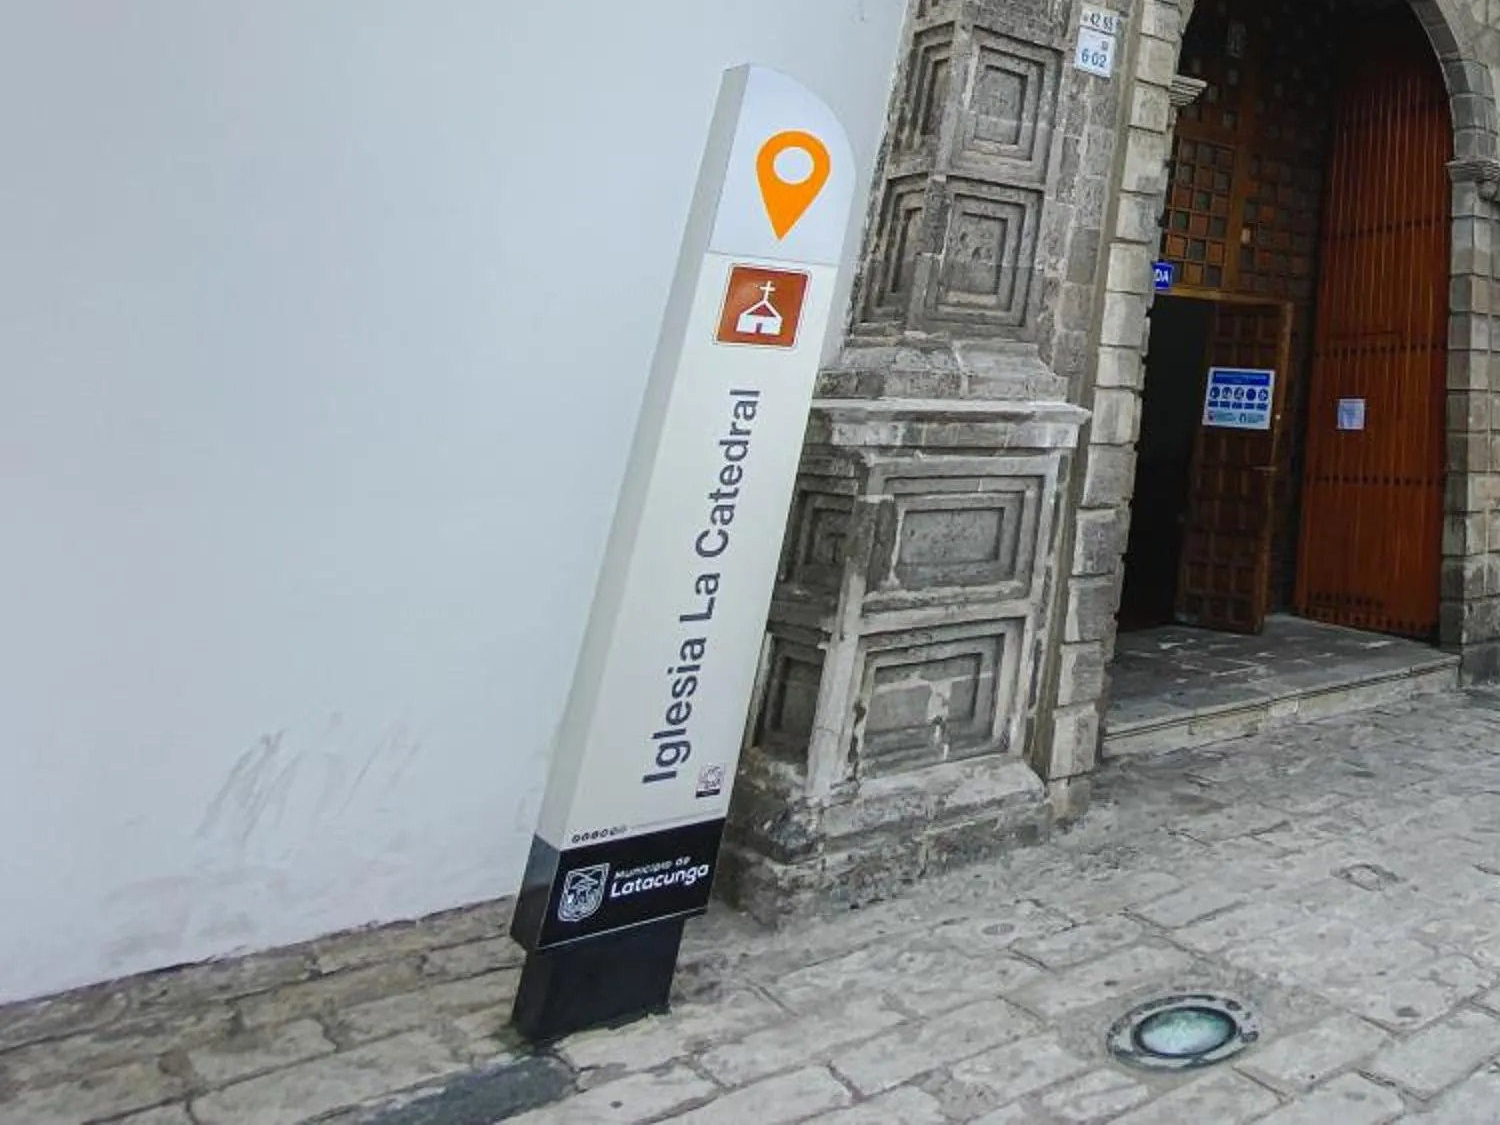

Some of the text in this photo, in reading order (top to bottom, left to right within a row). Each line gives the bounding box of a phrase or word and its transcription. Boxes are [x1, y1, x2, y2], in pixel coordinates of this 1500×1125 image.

[642, 389, 761, 784] Iglesia La Catedral
[610, 864, 710, 898] Latacunga
[614, 856, 691, 879] Municipio de
